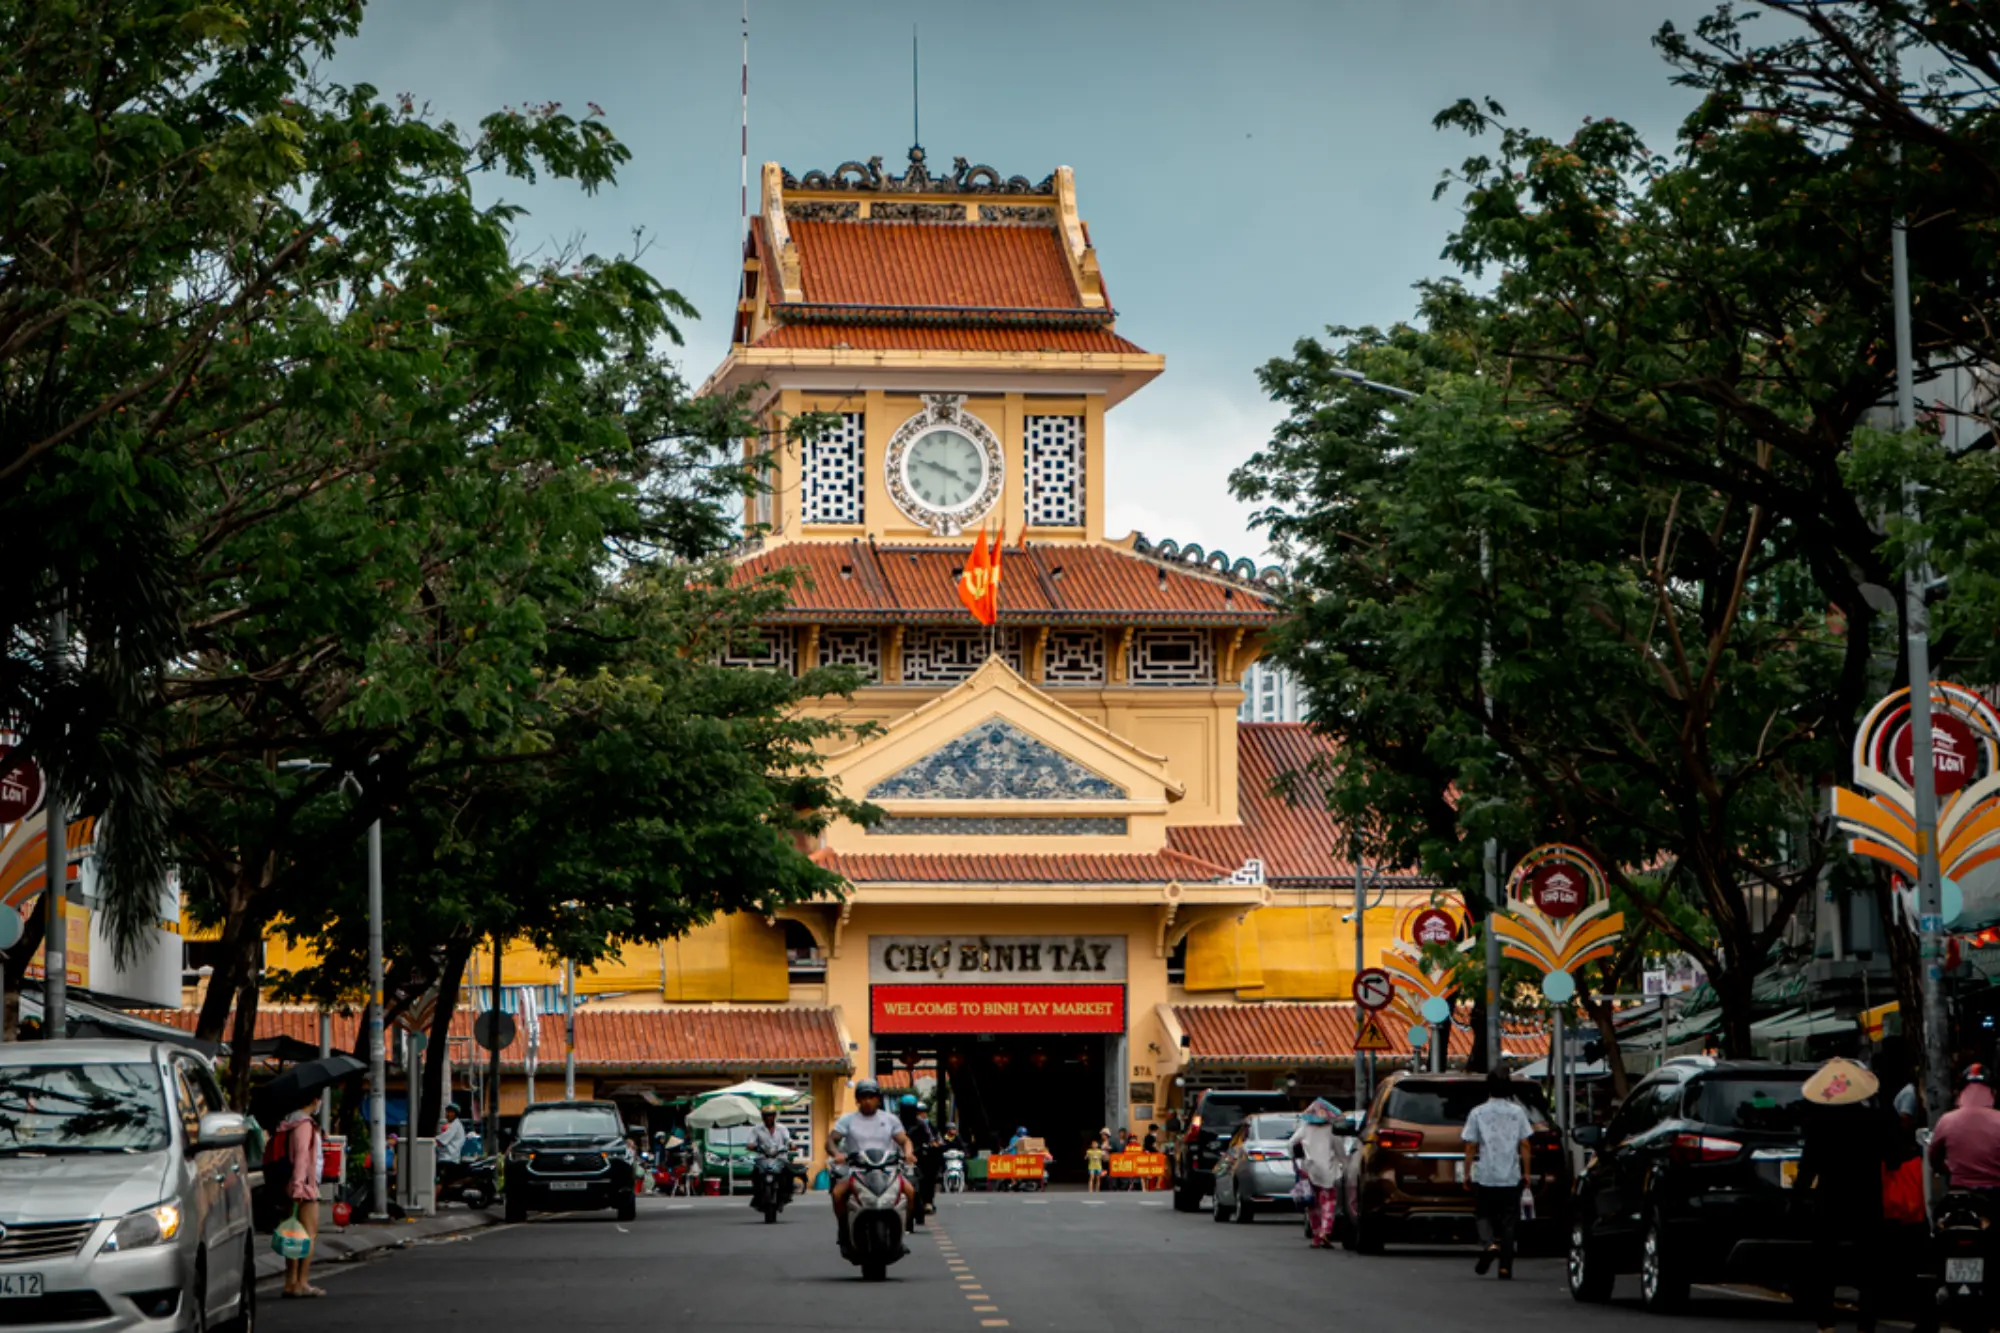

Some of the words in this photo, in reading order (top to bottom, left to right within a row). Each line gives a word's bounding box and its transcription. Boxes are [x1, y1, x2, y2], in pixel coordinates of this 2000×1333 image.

[884, 940, 951, 979] CHỢ
[959, 936, 1042, 972] BÌNH
[1046, 937, 1112, 972] TÂY
[884, 1002, 958, 1016] WELCOME
[961, 1002, 980, 1016] TO
[983, 1002, 1019, 1016] BINH
[1022, 1002, 1050, 1016] TAY
[1052, 1002, 1114, 1016] MARKET
[0, 1275, 39, 1295] 4.12
